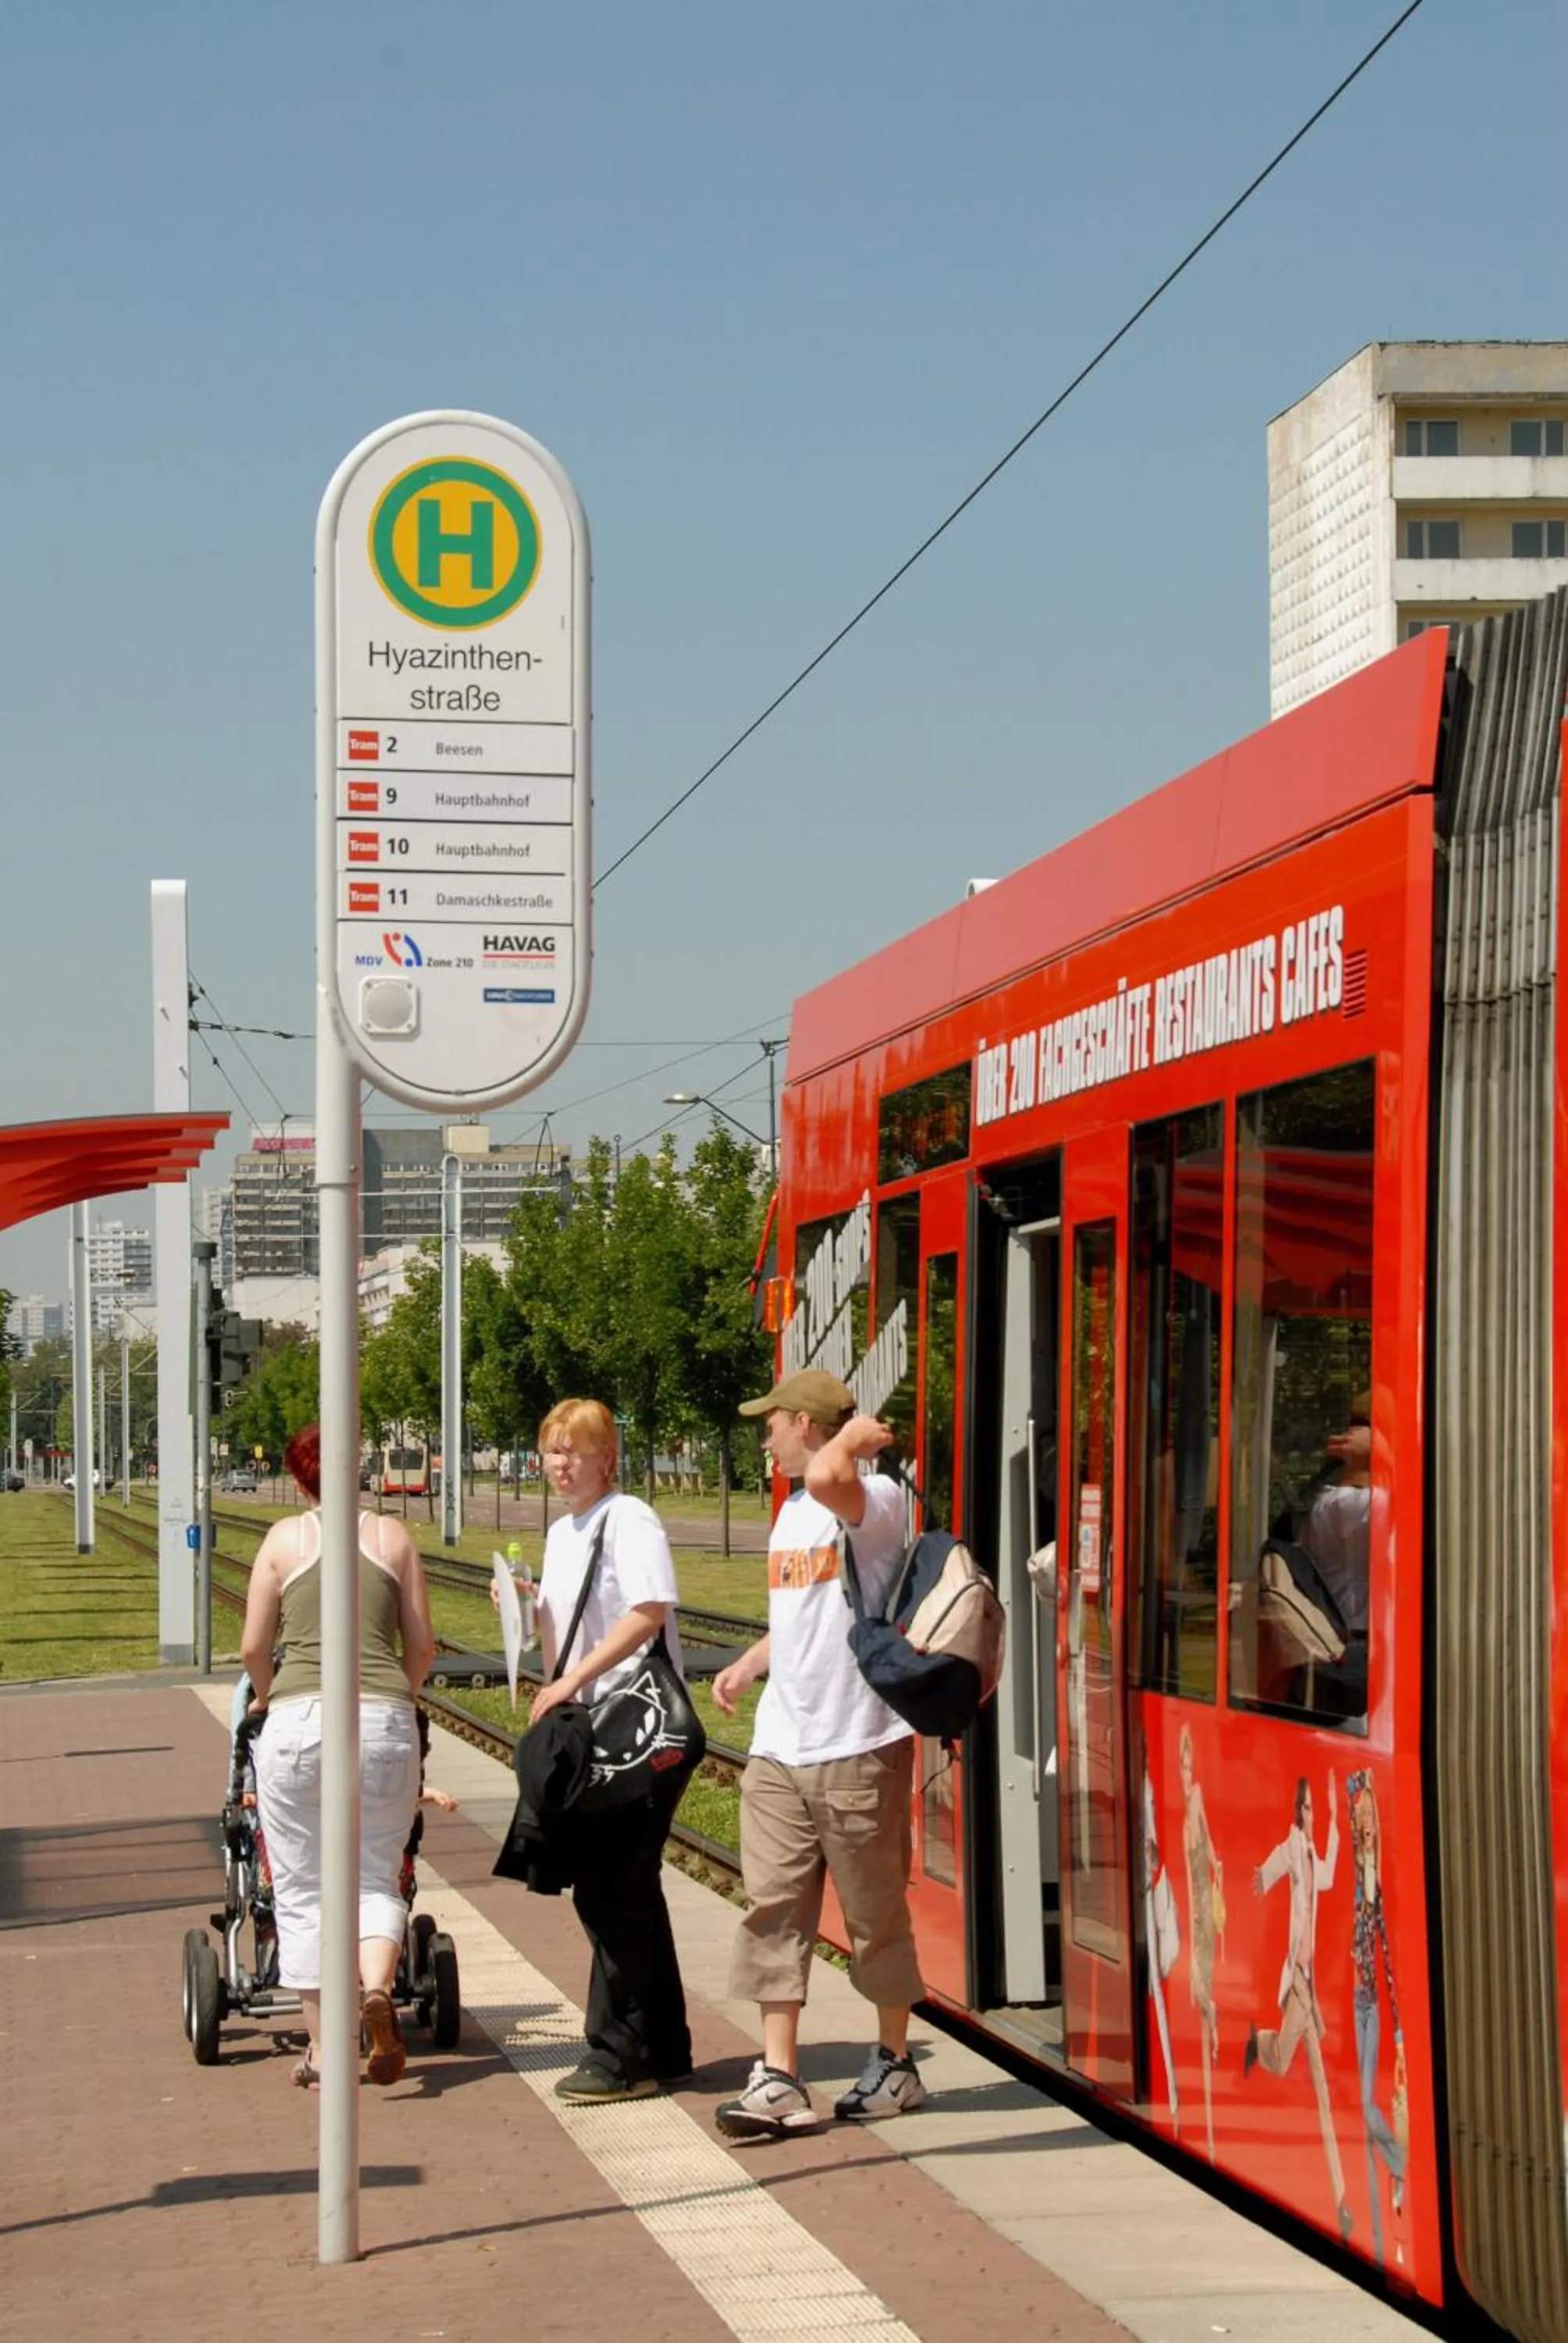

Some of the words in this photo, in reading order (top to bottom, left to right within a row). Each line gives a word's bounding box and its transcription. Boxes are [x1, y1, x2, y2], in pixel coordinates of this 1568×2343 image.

[418, 499, 494, 590] H
[369, 641, 543, 674] Hyazinthen-
[410, 685, 501, 711] straße
[349, 738, 378, 751] Tram
[386, 736, 398, 753] 2
[436, 742, 483, 756] Beesen
[349, 789, 378, 801] Tram
[386, 787, 397, 804] 9
[435, 793, 530, 808] Hauptbahnhof
[349, 840, 378, 852] Tram
[387, 838, 409, 855] 10
[436, 843, 530, 858] Hauptbahnhof
[349, 890, 378, 902] Tram
[387, 889, 409, 905] 11
[437, 893, 553, 908] Damaschkestraße
[483, 936, 555, 952] HAVAG
[355, 955, 383, 966] MDV
[426, 958, 452, 968] Zone
[456, 958, 473, 968] 210
[1009, 1030, 1036, 1114] 200
[1038, 976, 1151, 1105] FACHGESCHÄFTE
[1153, 934, 1276, 1065] RESTAURANTS
[1281, 904, 1344, 1025] CAFES
